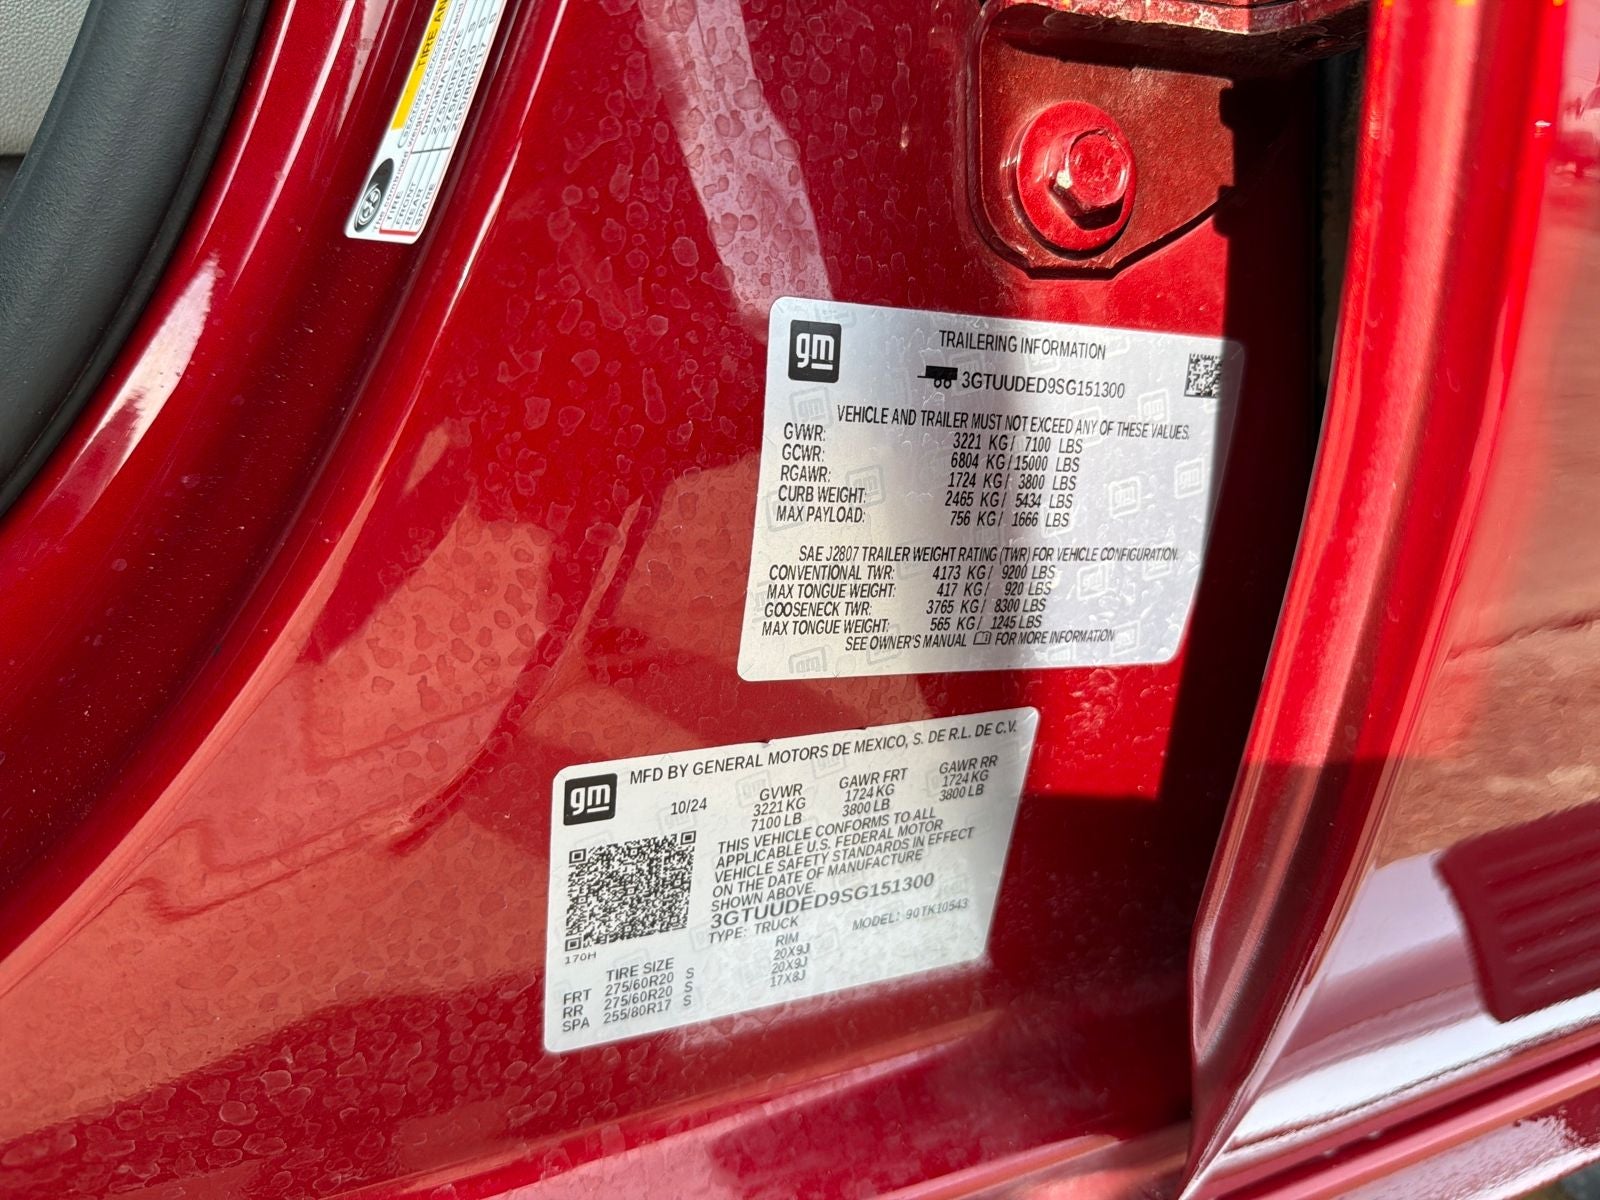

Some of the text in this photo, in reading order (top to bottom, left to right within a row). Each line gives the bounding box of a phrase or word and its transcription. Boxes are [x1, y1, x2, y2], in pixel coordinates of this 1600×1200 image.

[417, 29, 438, 70] TIRE
[386, 29, 464, 220] TIRE ORIGINAL SIZE
[396, 182, 416, 225] FRONT
[406, 182, 423, 225] REAR
[416, 183, 435, 225] SPARE
[796, 332, 835, 370] gm
[939, 329, 1106, 360] TRAILERING INFORMATION
[962, 371, 1125, 398] 3GTUUDED9SG151300
[838, 404, 889, 424] VEHICLE
[891, 408, 916, 425] AND
[921, 409, 968, 428] TRAILER
[971, 414, 1002, 430] MUST
[1005, 415, 1029, 431] NOT
[1030, 417, 1072, 434] EXCEED
[1075, 420, 1097, 435] ANY
[1100, 420, 1114, 436] OF
[1118, 422, 1149, 438] THESE
[784, 423, 1083, 454] GVWR: 3221 7100 LBS
[782, 444, 1080, 473] GCWR: 6804 LBS
[781, 465, 1076, 491] RGAWR: 1724 3800 LBS
[778, 485, 1073, 509] CURB WEIGHT: 2465 5434 LBS
[776, 506, 1070, 527] MAX PAYLOAD: 756 1666 LBS
[799, 545, 1097, 566] SAE J2807 TRAILER WEIGHT RATING (TWR) FOR VEHICLE
[769, 565, 1055, 580] CONVENTIONAL TWR: 4173 9200 LBS
[767, 582, 1051, 599] MAX TONGUE WEIGHT: 417 920 LBS
[765, 598, 1046, 617] GOOSENECK TWR: 3765 8300 LBS
[762, 615, 1042, 636] MAX TONGUE WEIGHT: 565 1245 LBS
[845, 636, 868, 651] SEE
[870, 635, 921, 650] OWNER'S
[923, 634, 966, 648] MANUAL
[995, 632, 1016, 646] FOR
[1018, 631, 1048, 645] MORE
[630, 720, 1017, 784] MFD BY GENERAL MOTORS DE MEXICO, S. DE R.L. DE C.V.
[753, 769, 989, 817] 3221 KG 1724 KG 1724 KG
[760, 755, 998, 801] GVWR GAWR FRT GAWR RR
[570, 784, 610, 816] gm
[671, 797, 708, 815] 10/24
[751, 784, 984, 832] 7100 LB 3800 LB 3800 LB
[716, 819, 943, 868] APPLICABLE U.S. FEDERAL MOTOR
[718, 807, 936, 854] THIS VEHICLE CONFORMS TO ALL
[714, 827, 974, 883] VEHICLE SAFETY STANDARDS IN EFFECT
[713, 850, 922, 899] ON THE DATE OF MANUFACTURE
[711, 882, 816, 913] SHOWN ABOVE.
[711, 873, 935, 929] 3GTUUDED9SG151300
[709, 928, 748, 944] TYPE:
[755, 915, 799, 935] TRUCK
[852, 912, 901, 931] MODEL:
[776, 932, 799, 947] RIM
[773, 943, 811, 961] 20X9J
[607, 957, 674, 982] TIRE SIZE
[562, 981, 693, 1019] RR 275/60R20 S
[563, 967, 694, 1005] FRT 275/60R20 S
[562, 995, 692, 1033] SPA 255/80R17 S
